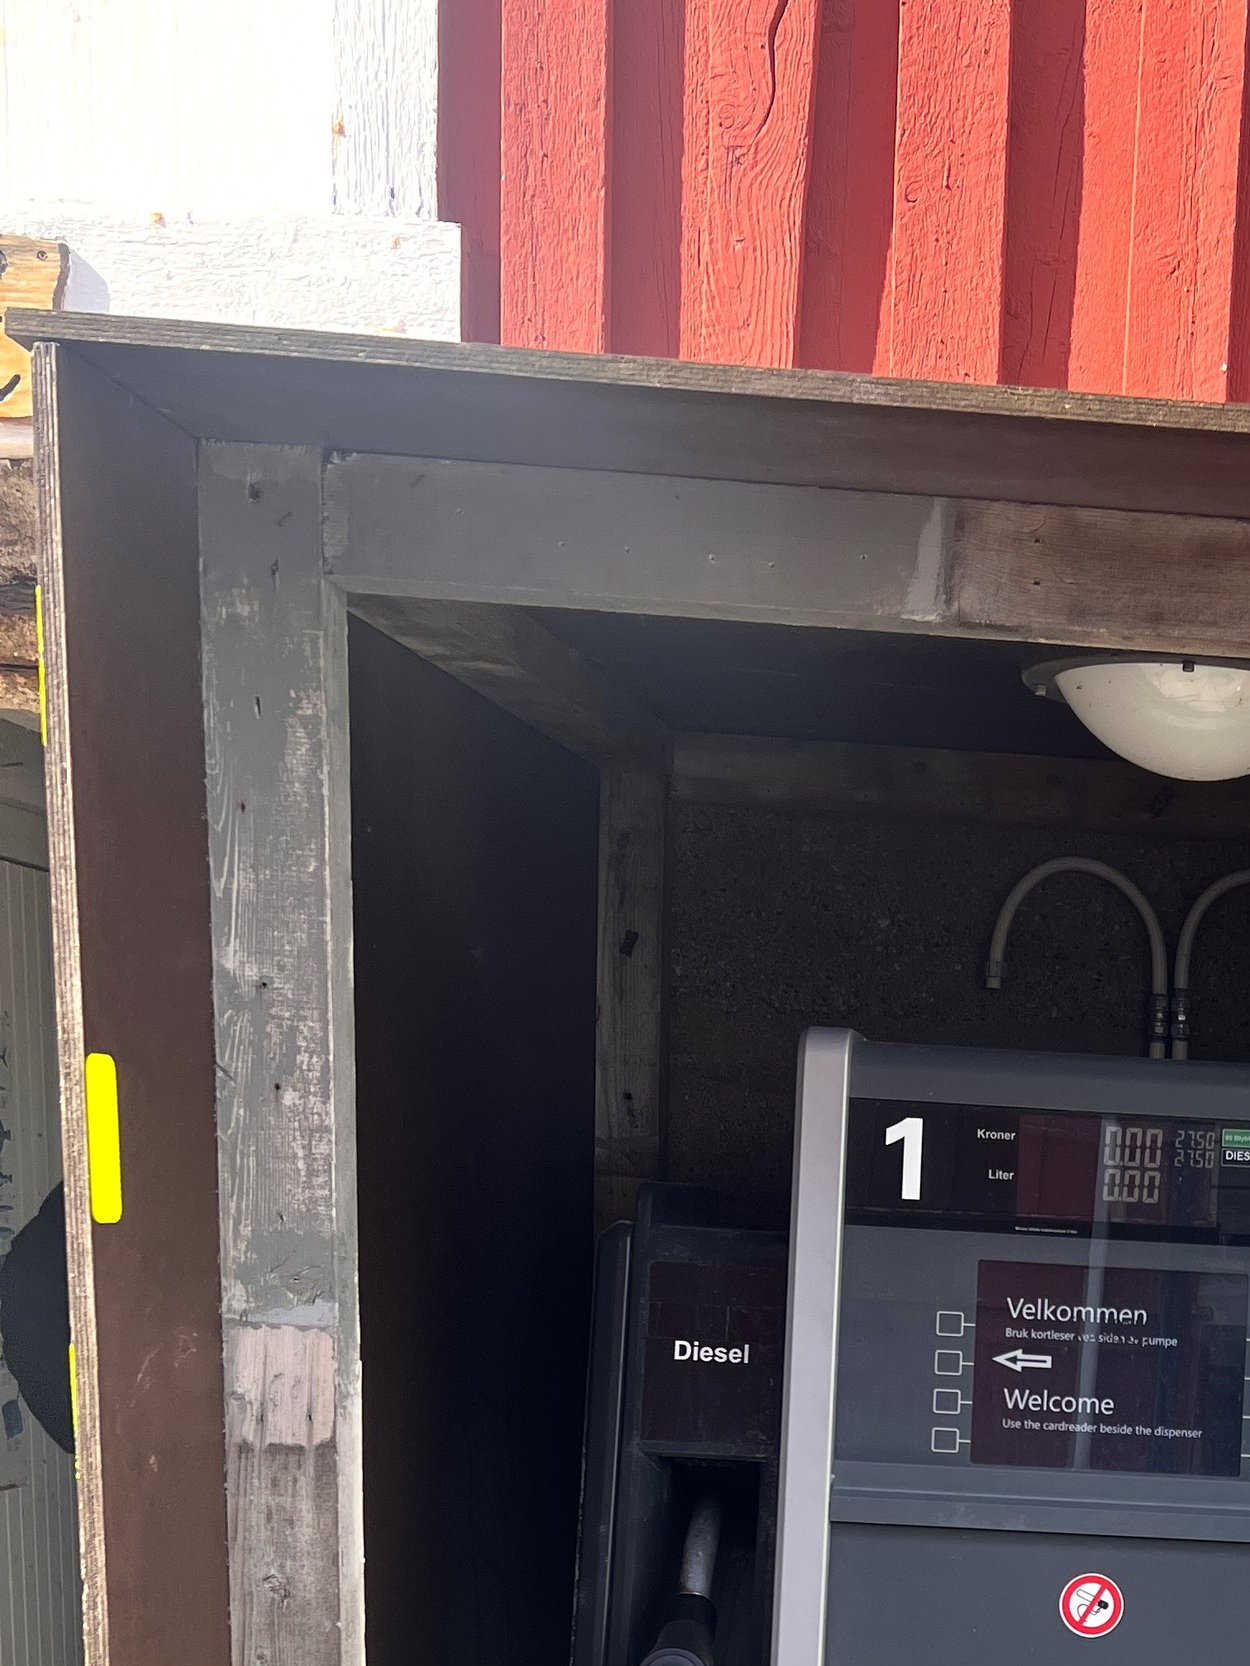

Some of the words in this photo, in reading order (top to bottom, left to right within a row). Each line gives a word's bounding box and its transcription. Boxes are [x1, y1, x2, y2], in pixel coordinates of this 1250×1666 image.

[976, 1128, 1016, 1140] Kroner
[885, 1117, 923, 1200] 1
[988, 1168, 1015, 1180] Liter
[1006, 1296, 1148, 1326] Velkommen
[1005, 1327, 1029, 1338] Bruk
[1031, 1329, 1075, 1341] kortleser
[673, 1340, 750, 1364] Diesel
[1003, 1387, 1115, 1415] Welcome
[1002, 1418, 1022, 1429] Use
[1023, 1419, 1041, 1430] the
[1042, 1420, 1098, 1433] cardreader
[1099, 1423, 1133, 1435] beside
[1135, 1425, 1152, 1436] the
[1154, 1426, 1203, 1440] dispenser
